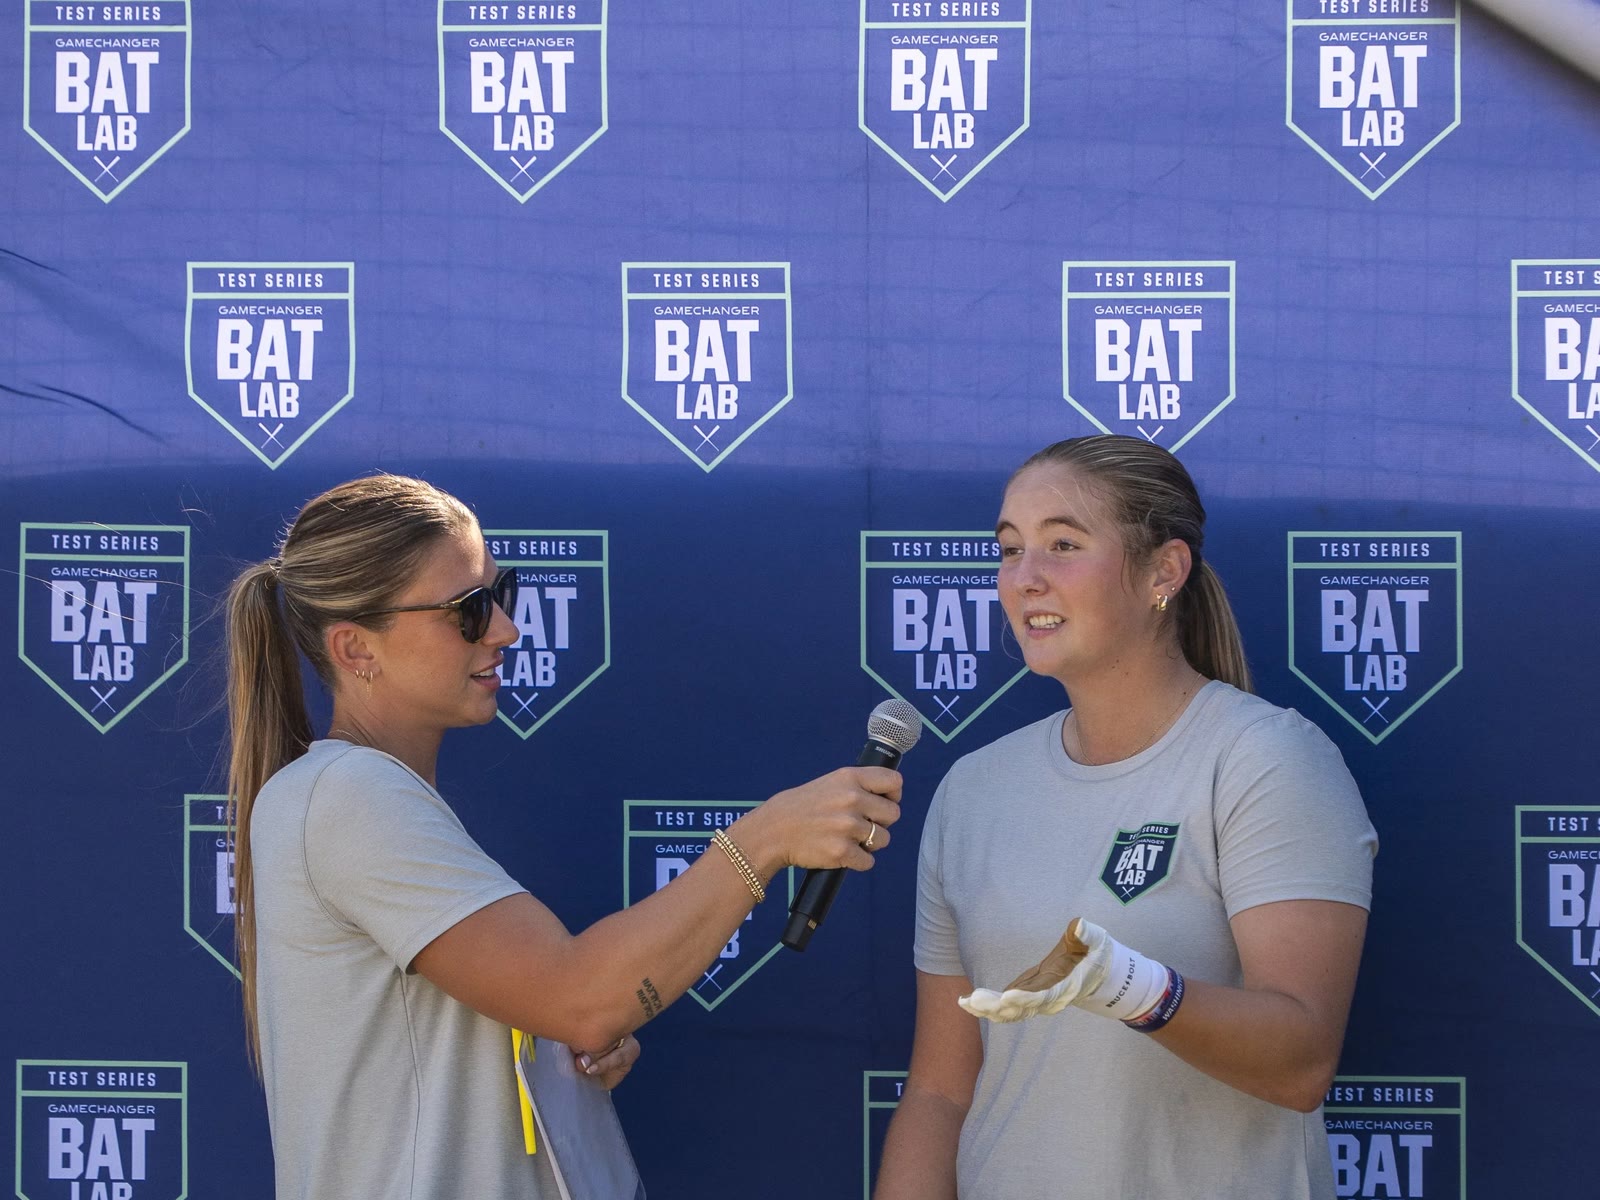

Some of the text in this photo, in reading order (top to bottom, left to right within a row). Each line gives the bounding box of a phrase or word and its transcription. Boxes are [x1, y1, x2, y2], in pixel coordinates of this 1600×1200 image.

[56, 7, 160, 20] TEST SERIES
[470, 5, 575, 19] TEST SERIES
[892, 2, 999, 16] TEST SERIES
[1320, 0, 1428, 13] TEST SERIES
[56, 39, 159, 47] GAMECHANGER
[470, 38, 574, 47] GAMECHANGER
[891, 35, 998, 44] GAMECHANGER
[1319, 32, 1427, 41] GAMECHANGER
[56, 52, 159, 113] BAT
[470, 51, 574, 112] BAT
[891, 48, 997, 110] BAT
[1320, 45, 1427, 108] BAT
[77, 116, 136, 150] LAB
[494, 115, 554, 150] LAB
[914, 113, 974, 148] LAB
[1342, 110, 1404, 146] LAB
[218, 274, 322, 287] TEST SERIES
[654, 274, 758, 287] TEST SERIES
[1095, 272, 1203, 286] TEST SERIES
[1544, 271, 1584, 284] TEST
[219, 306, 322, 314] GAMECHANGER
[654, 306, 759, 315] GAMECHANGER
[1095, 306, 1202, 314] GAMECHANGER
[1544, 304, 1600, 312] GAMECH
[217, 319, 322, 380] BAT
[655, 320, 759, 381] BAT
[1096, 319, 1202, 381] BAT
[240, 382, 298, 417] LAB
[677, 384, 738, 419] LAB
[1119, 384, 1180, 419] LAB
[1568, 383, 1600, 418] LA
[52, 535, 158, 550] TEST SERIES
[520, 541, 576, 555] SERIES
[892, 542, 999, 556] TEST SERIES
[1320, 543, 1429, 556] TEST SERIES
[51, 567, 157, 578] GAMECHANGER
[1320, 576, 1429, 584] GAMECHANGER
[51, 580, 157, 644] BAT
[509, 587, 577, 648] AT
[893, 589, 998, 651] BAT
[1321, 590, 1429, 652] BAT
[74, 645, 133, 681] LAB
[916, 654, 976, 689] LAB
[1345, 655, 1406, 690] LAB
[656, 812, 694, 825] TEST
[1548, 817, 1588, 831] TEST
[1142, 826, 1170, 834] SERIES
[1114, 844, 1163, 873] BAT
[1116, 869, 1146, 886] LAB
[1127, 957, 1136, 981] BOLT
[48, 1072, 155, 1086] TEST SERIES
[1374, 1088, 1433, 1102] SERIES
[48, 1104, 155, 1114] GAMECHANGER
[49, 1118, 154, 1180] BAT
[1327, 1134, 1432, 1198] BAT
